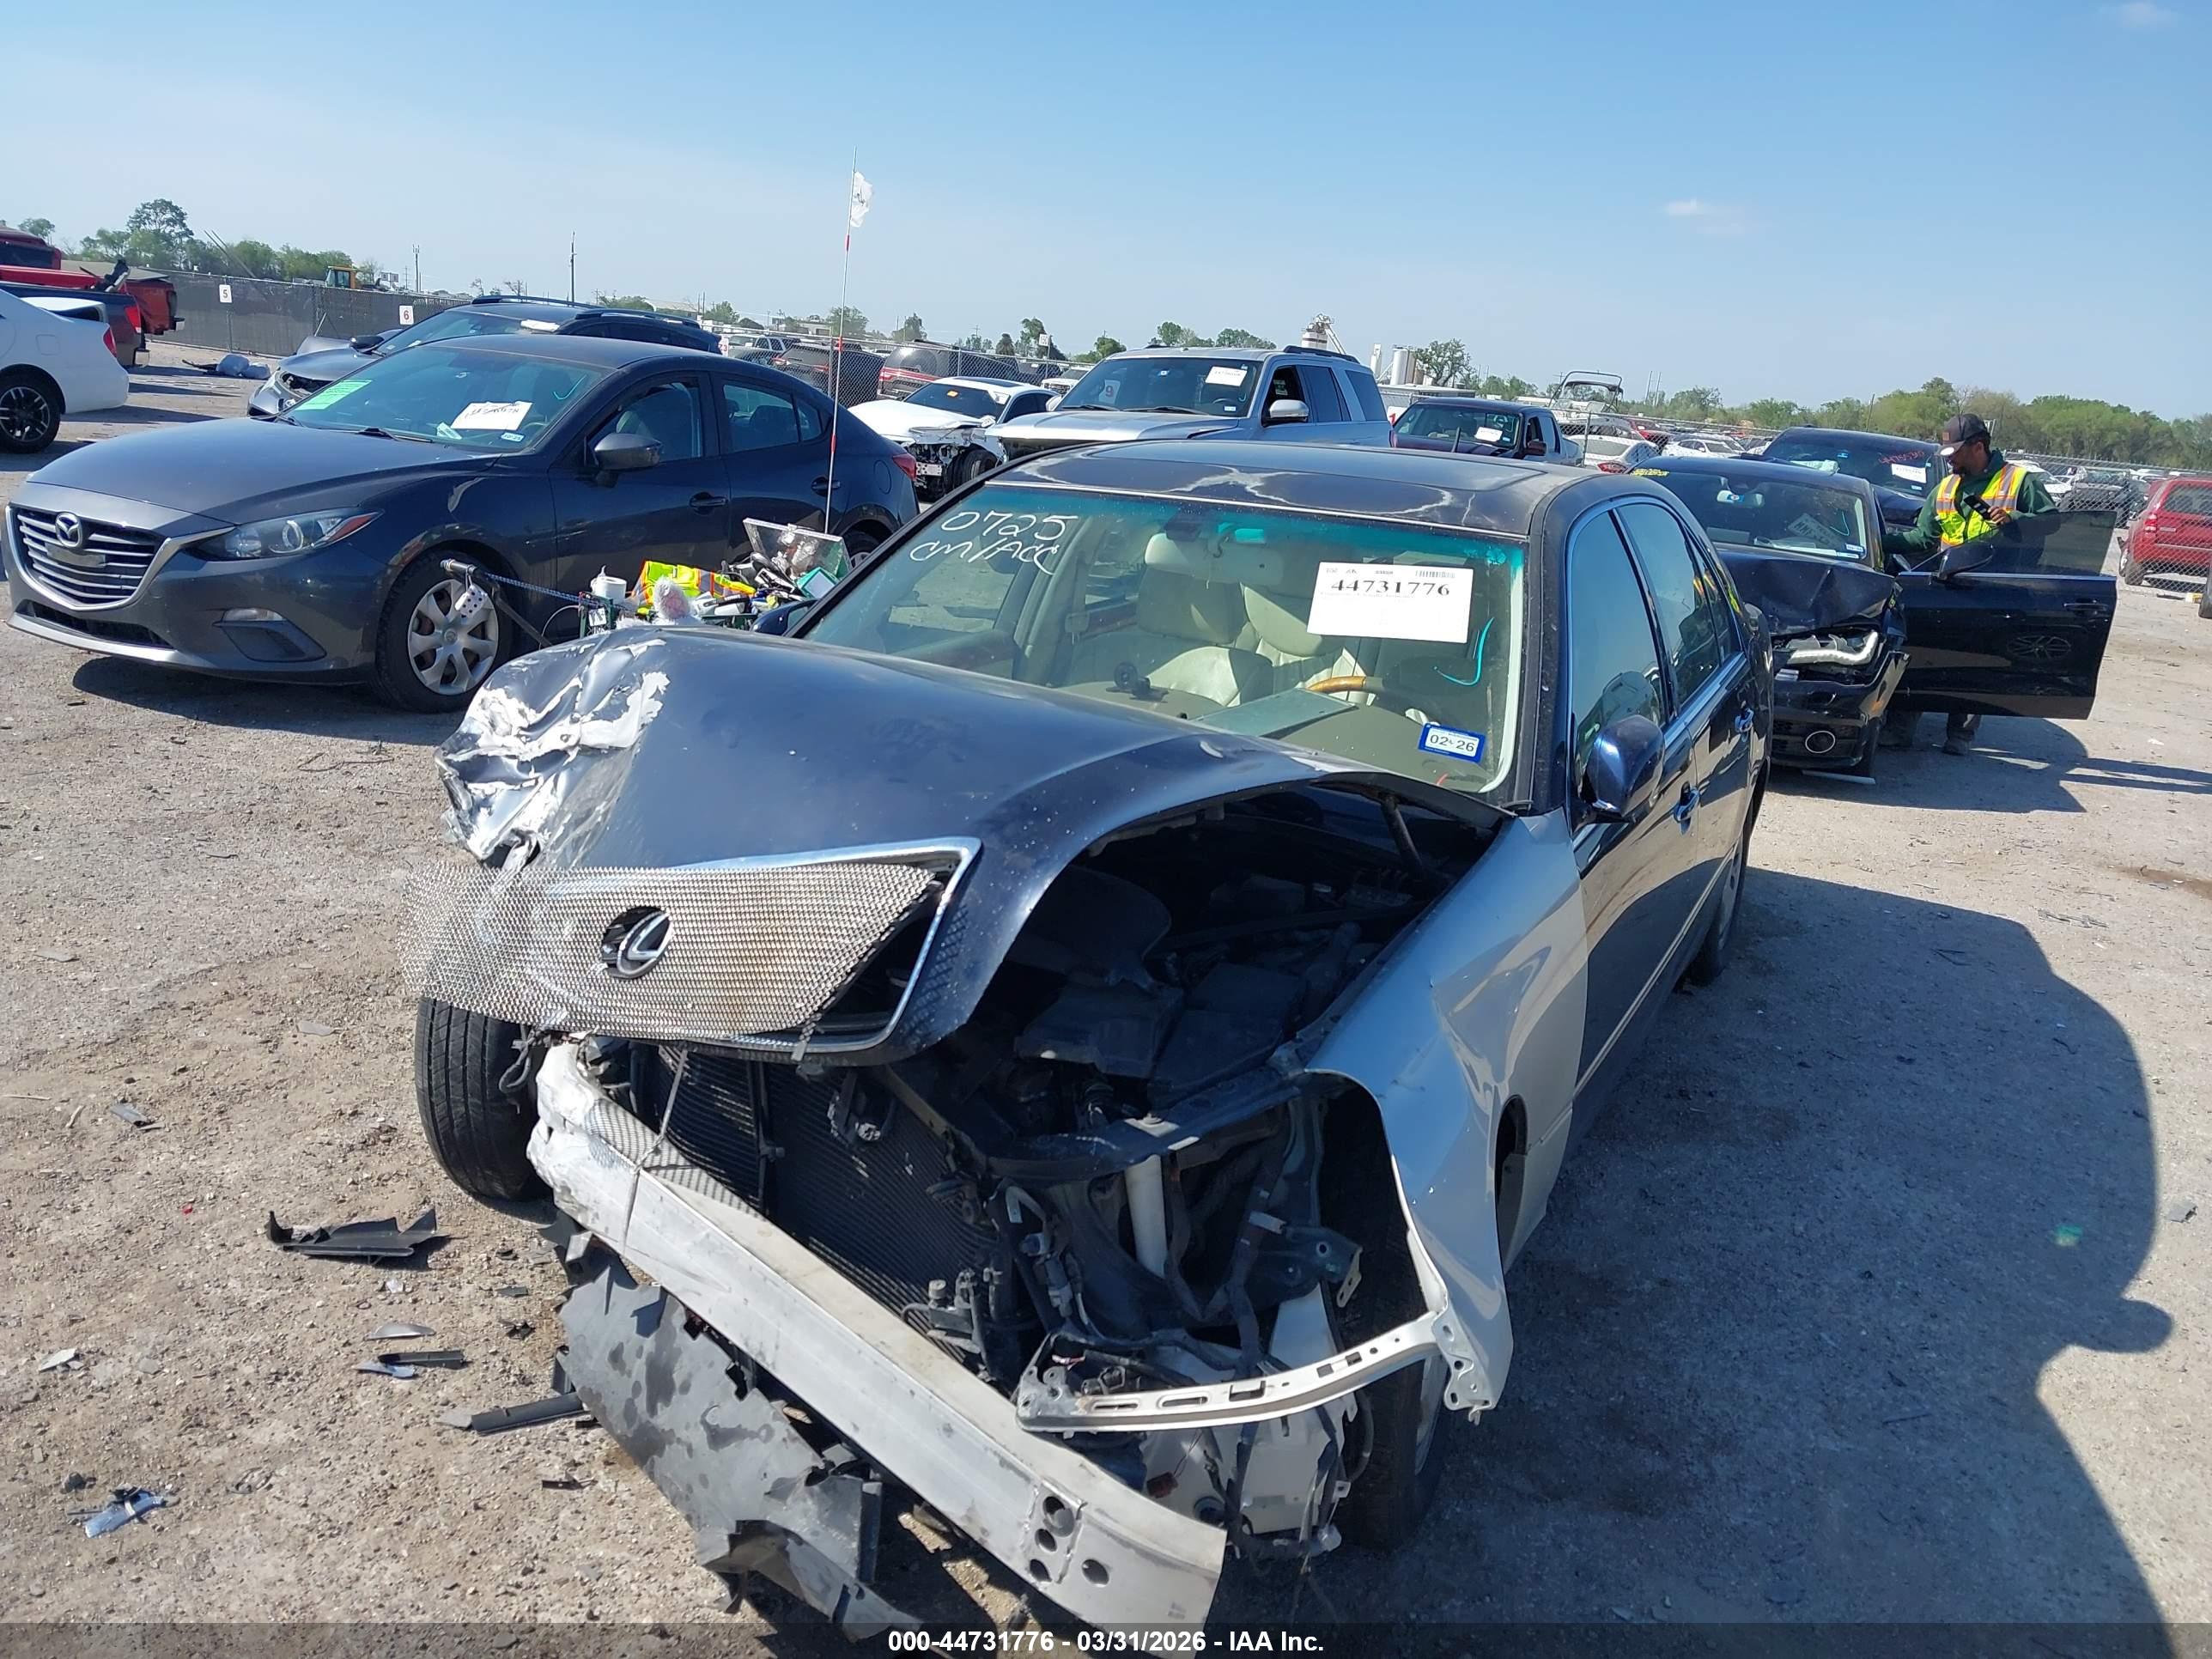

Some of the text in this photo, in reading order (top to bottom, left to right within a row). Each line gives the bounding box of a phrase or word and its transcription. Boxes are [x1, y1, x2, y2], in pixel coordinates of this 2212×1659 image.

[222, 289, 228, 299] 5
[403, 310, 410, 320] 6
[941, 510, 1079, 541] 0725
[1331, 579, 1450, 597] 44731776
[1430, 734, 1475, 752] 02 26
